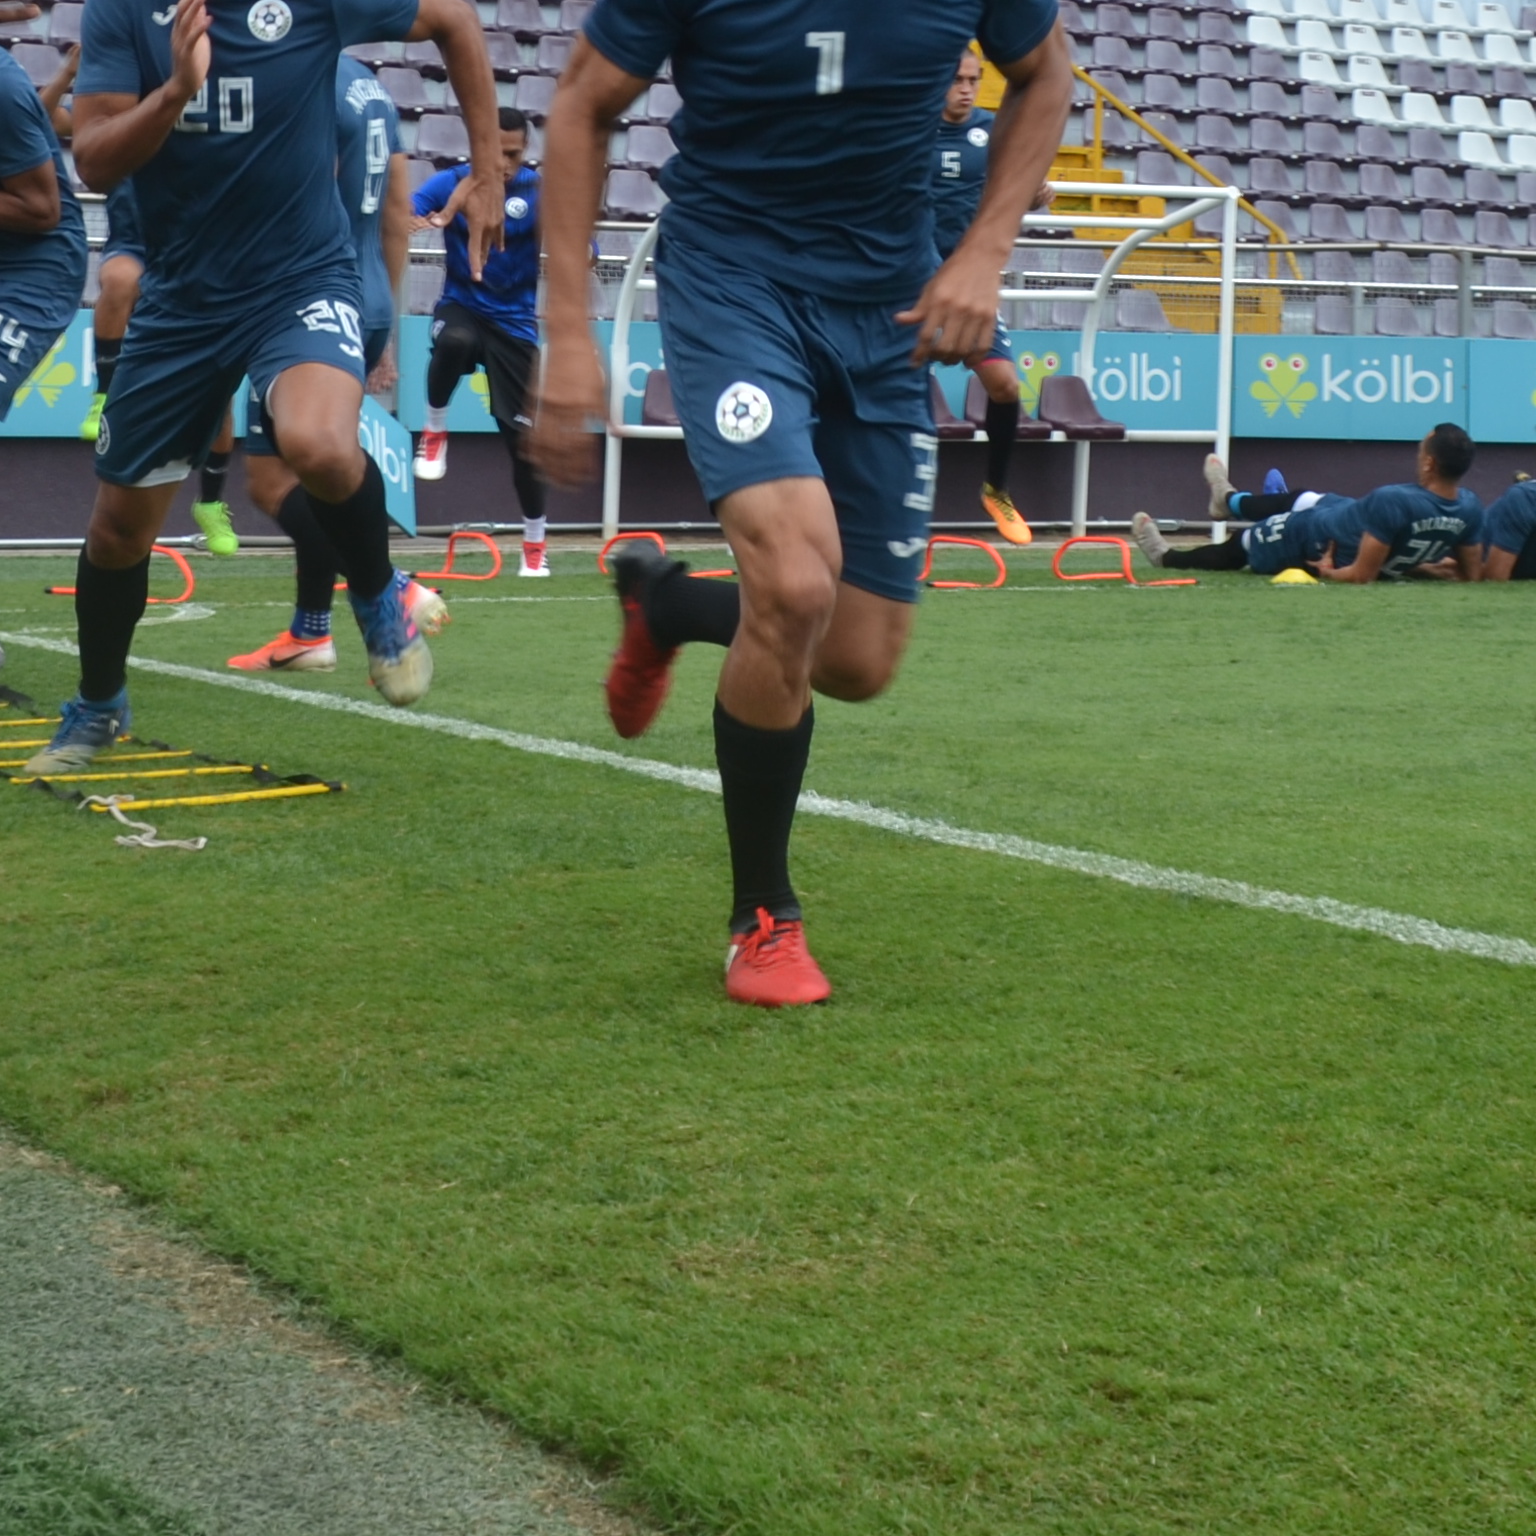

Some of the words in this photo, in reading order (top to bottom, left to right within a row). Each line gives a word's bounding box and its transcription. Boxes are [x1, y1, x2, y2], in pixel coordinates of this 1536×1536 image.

[805, 30, 846, 96] 1
[940, 150, 962, 178] 5
[296, 299, 364, 345] 20
[1321, 353, 1454, 404] kölbi
